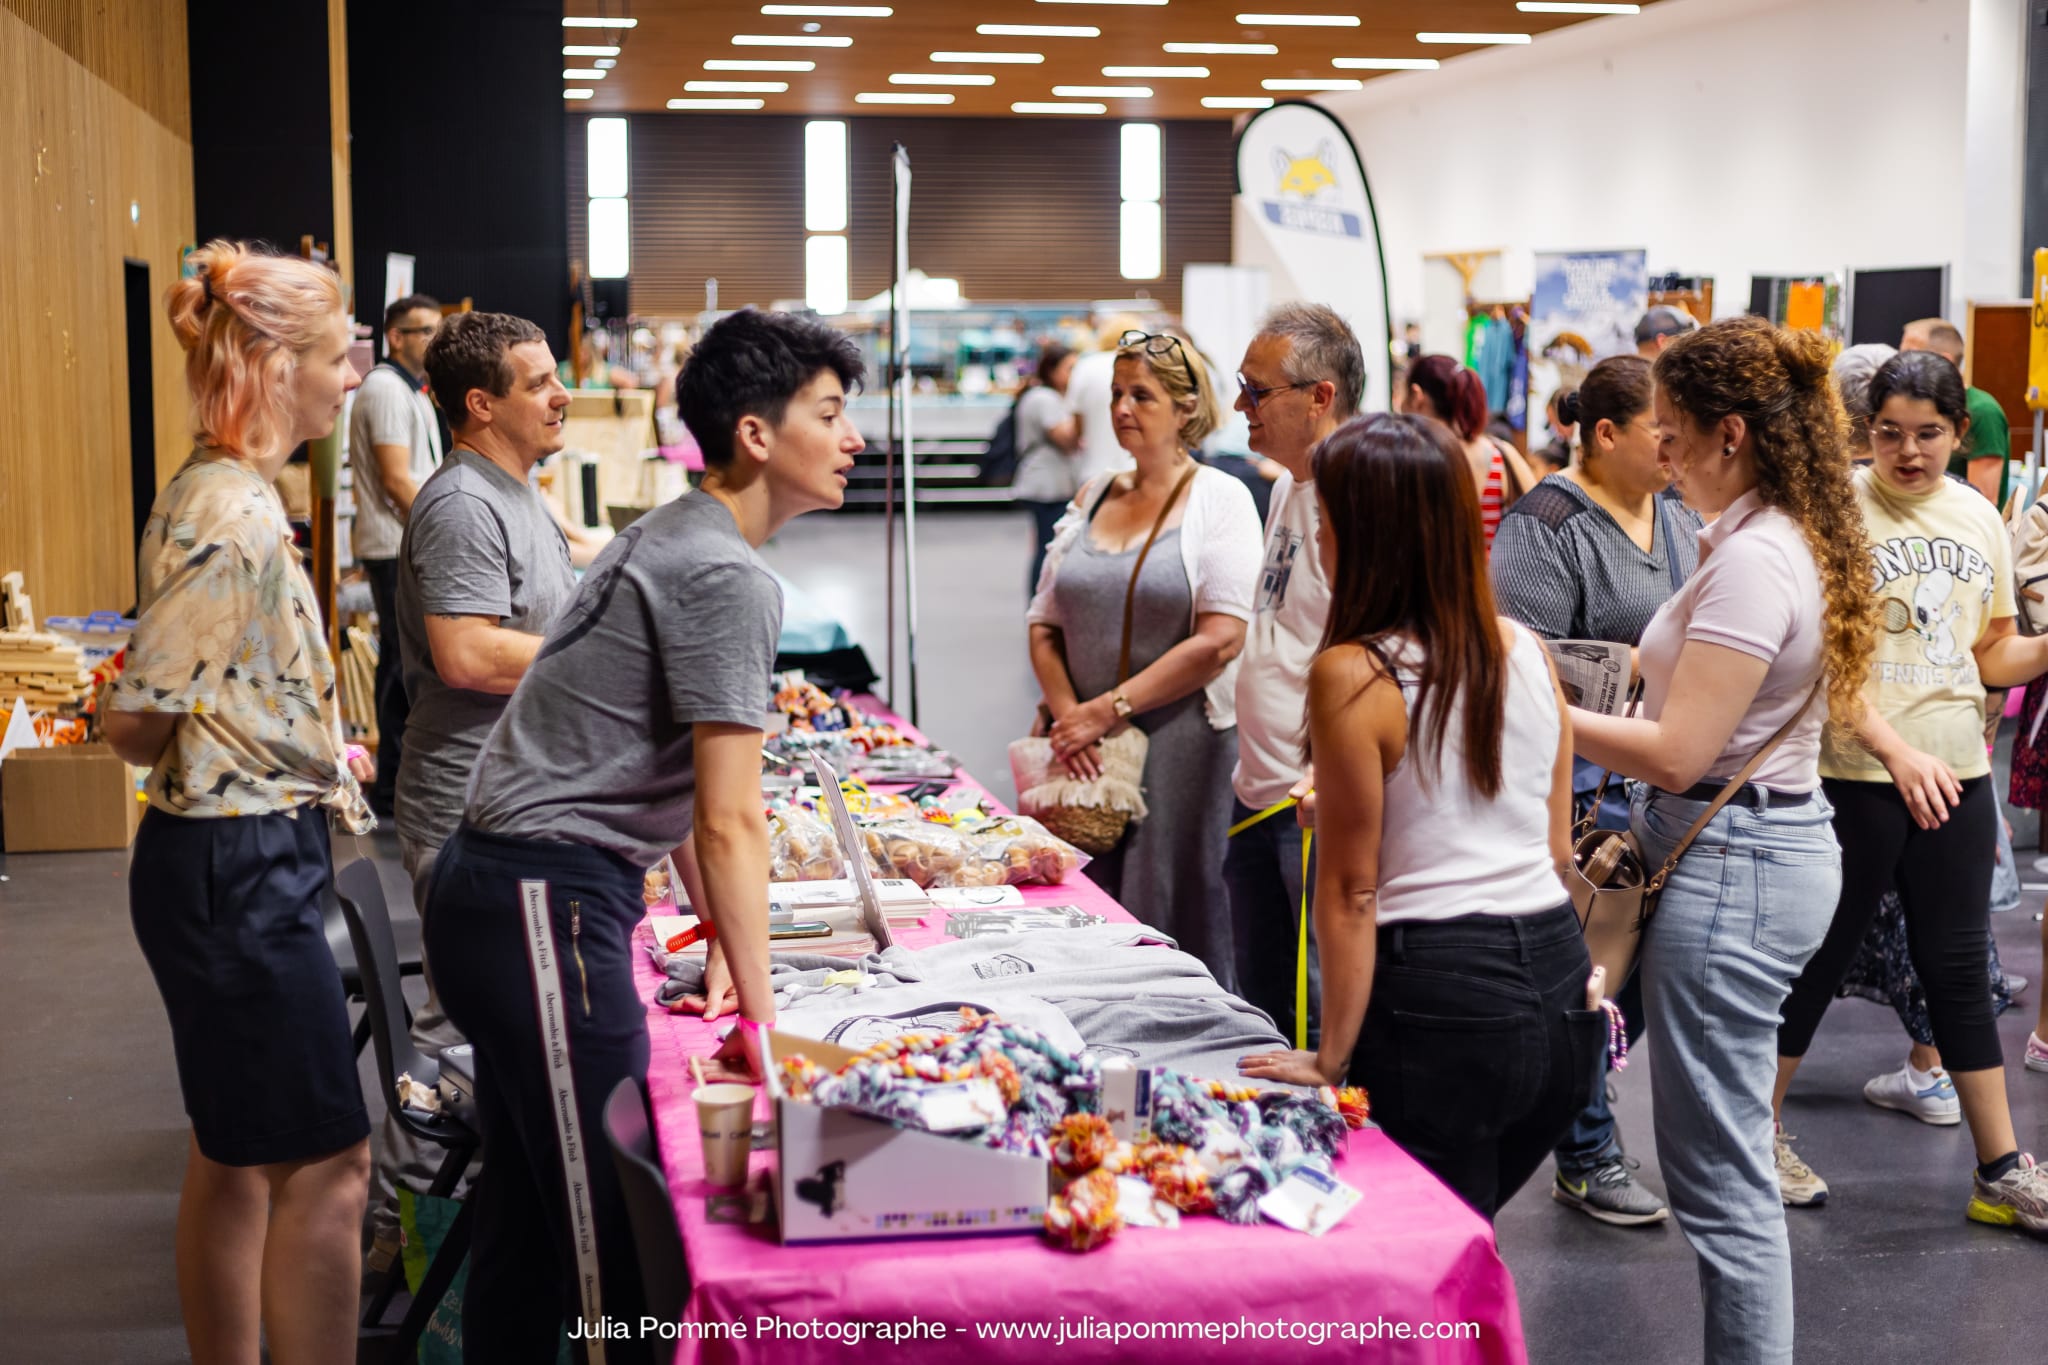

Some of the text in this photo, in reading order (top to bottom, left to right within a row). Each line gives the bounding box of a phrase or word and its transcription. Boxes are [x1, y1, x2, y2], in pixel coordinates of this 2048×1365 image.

[528, 888, 544, 938] Abercrombie
[538, 948, 550, 971] Fitch
[546, 991, 559, 1040] Abercrombie
[552, 1048, 564, 1069] Fitch
[558, 1088, 573, 1134] Abercrombie
[567, 1142, 578, 1163] Fitch
